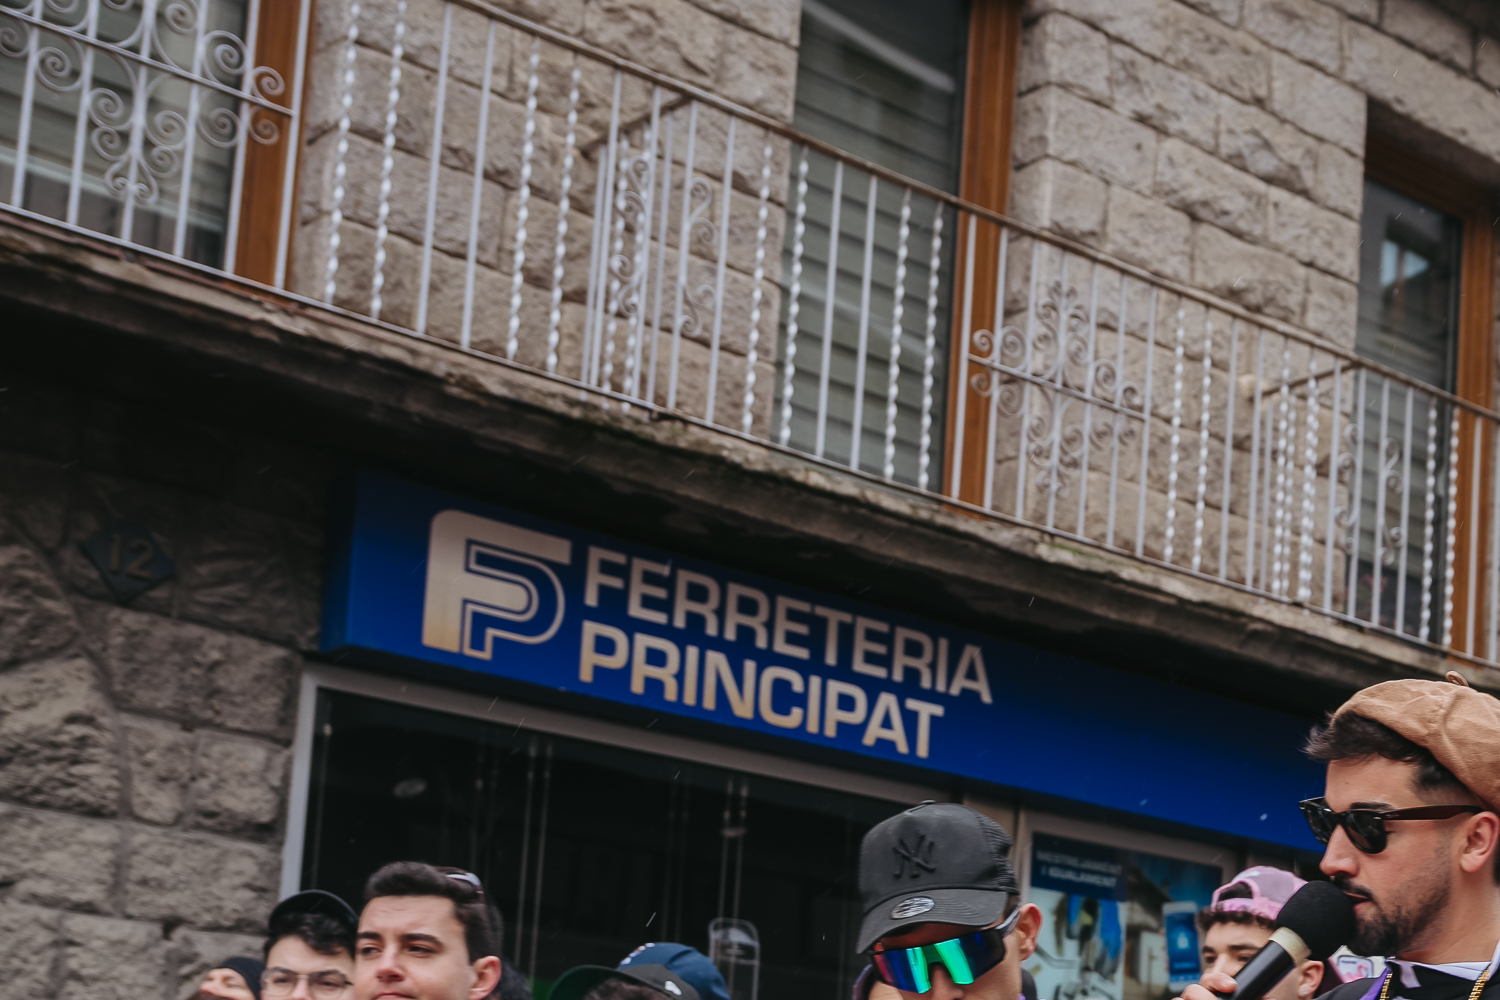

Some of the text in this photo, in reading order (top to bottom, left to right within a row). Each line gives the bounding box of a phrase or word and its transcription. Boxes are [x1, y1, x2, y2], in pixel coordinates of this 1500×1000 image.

[109, 533, 154, 579] 12
[584, 546, 993, 704] FERRETERIA
[579, 620, 944, 759] PRINCIPAT
